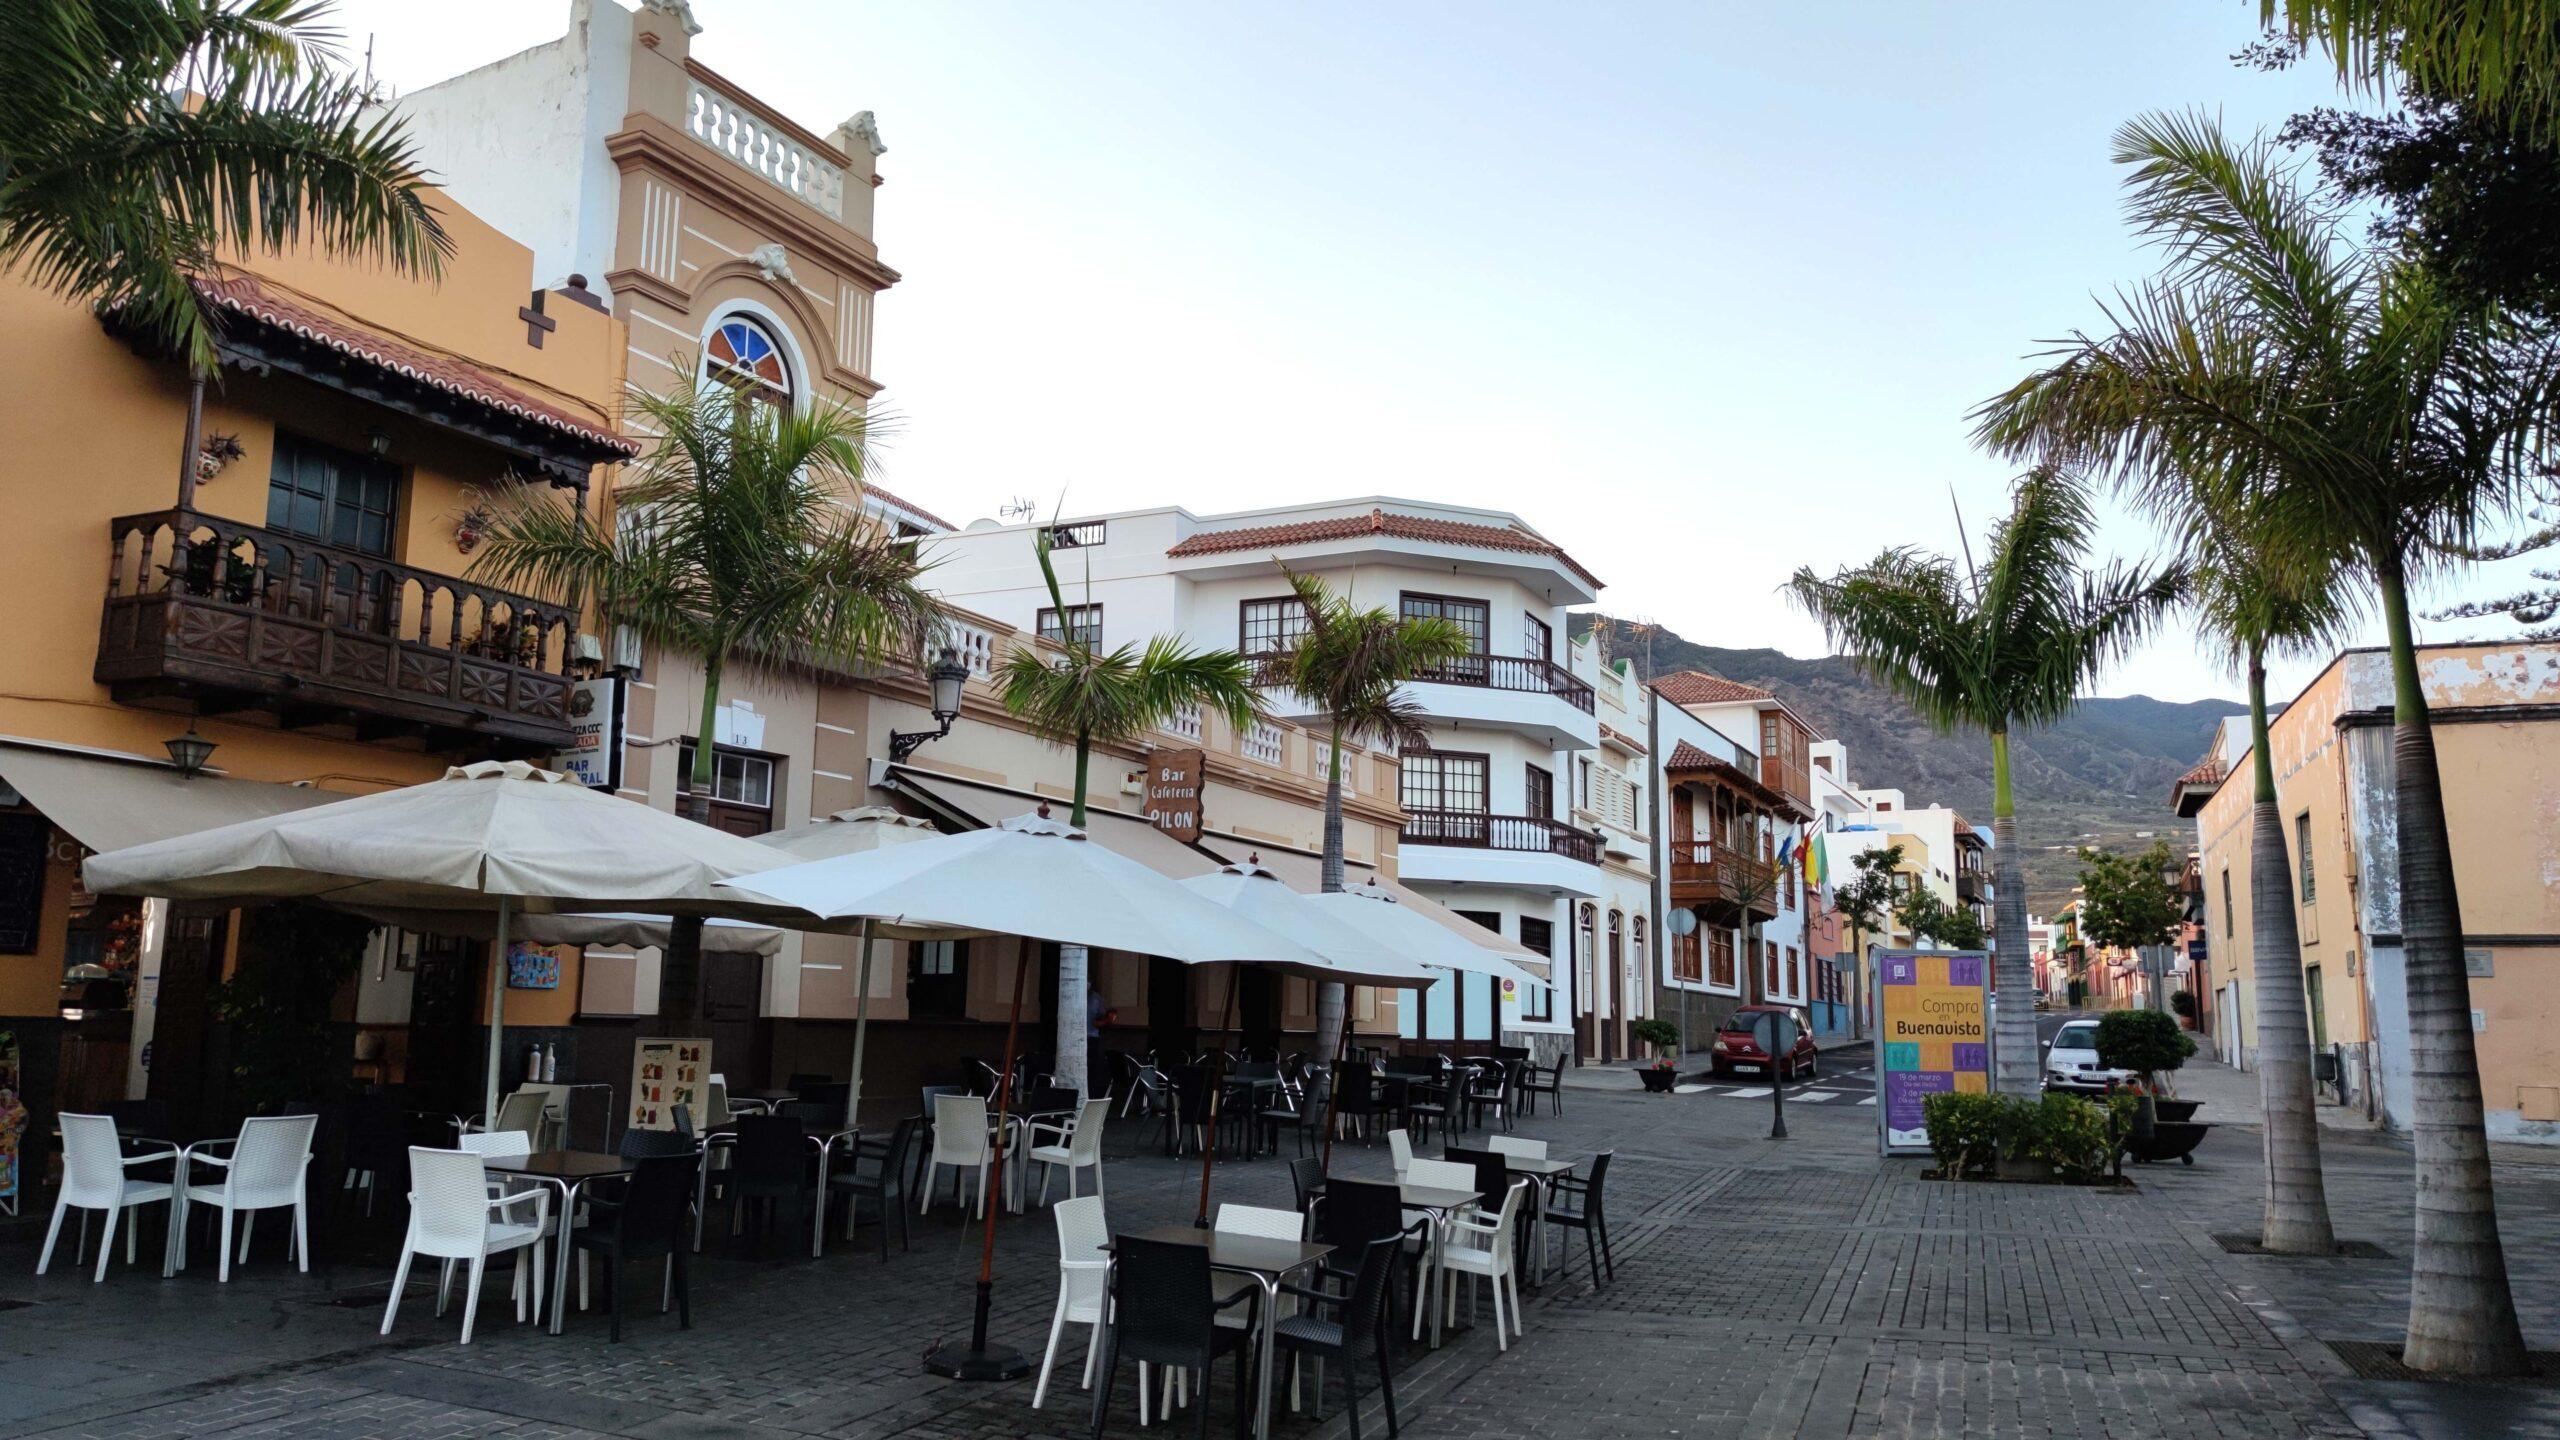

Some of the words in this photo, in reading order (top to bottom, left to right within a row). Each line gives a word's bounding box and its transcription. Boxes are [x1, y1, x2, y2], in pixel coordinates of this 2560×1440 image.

[576, 736, 596, 747] ADA
[566, 760, 588, 772] BAR
[1161, 768, 1185, 781] Bar
[1922, 999, 1979, 1017] Compra
[1897, 1021, 1981, 1036] Buenavista
[1898, 1073, 1907, 1081] 19
[1908, 1073, 1918, 1081] de
[1908, 1089, 1918, 1097] de
